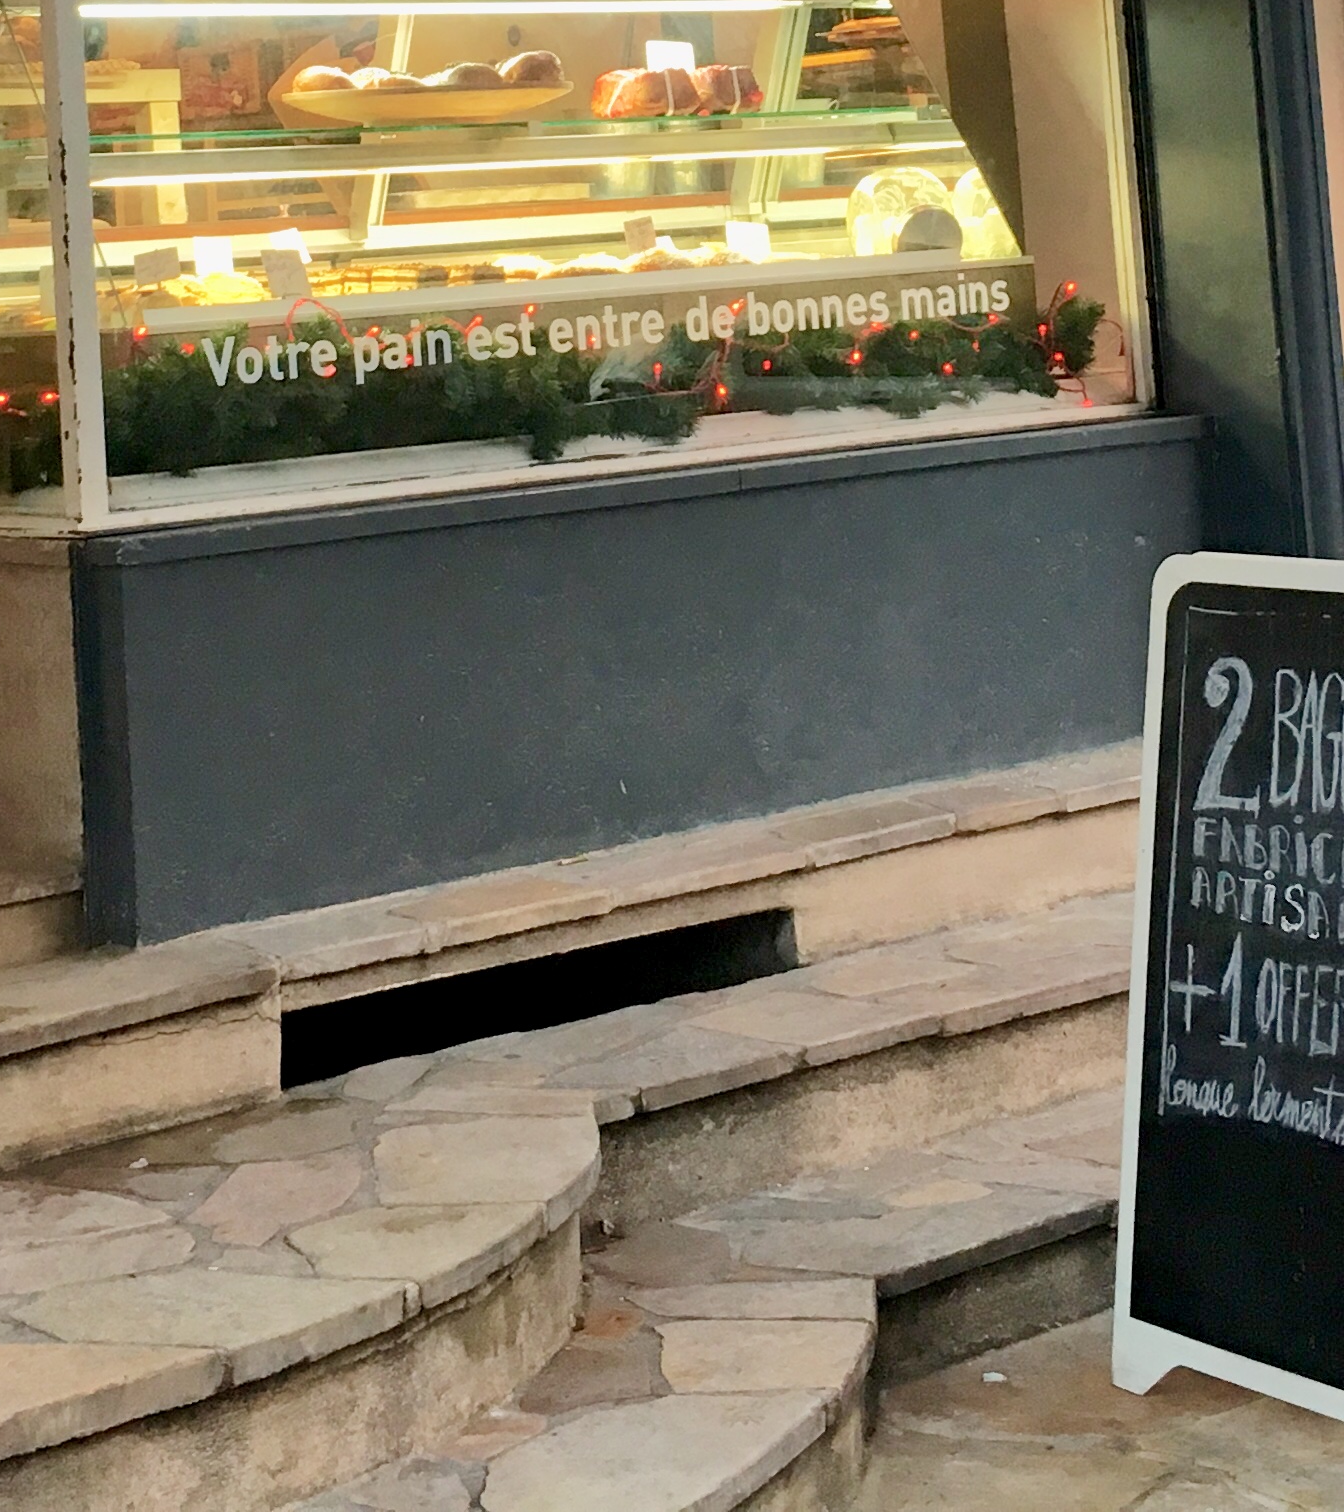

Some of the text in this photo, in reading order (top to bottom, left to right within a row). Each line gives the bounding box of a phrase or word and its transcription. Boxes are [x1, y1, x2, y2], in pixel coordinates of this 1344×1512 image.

[200, 273, 1011, 387] Votre pain est entre de bonnes mains
[1192, 656, 1261, 819] 2
